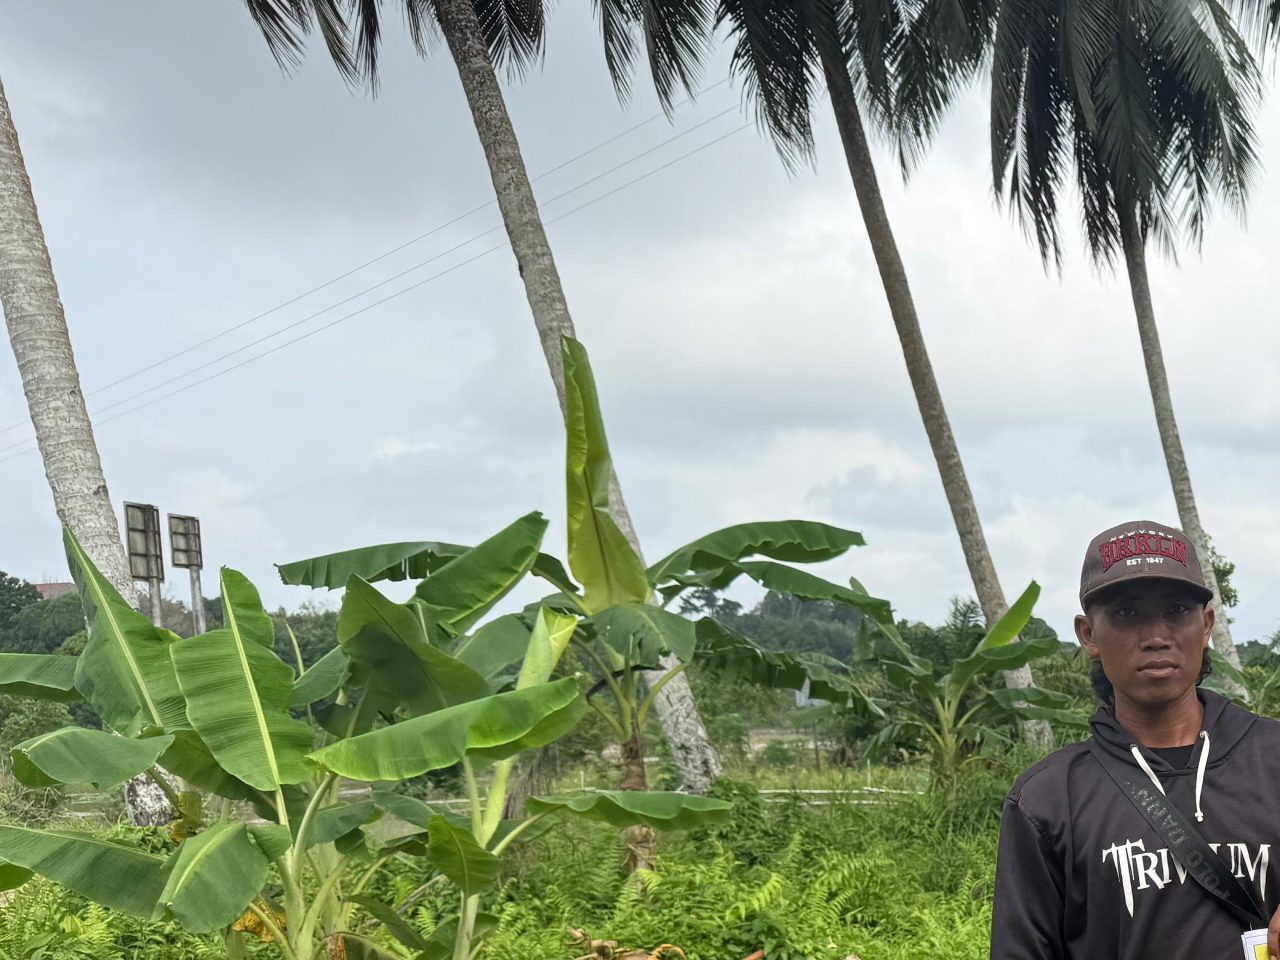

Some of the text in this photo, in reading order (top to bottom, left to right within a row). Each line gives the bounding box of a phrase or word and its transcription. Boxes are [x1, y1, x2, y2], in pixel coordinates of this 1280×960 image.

[1099, 533, 1188, 573] BRKLN
[1126, 558, 1142, 566] EST
[1102, 838, 1272, 918] TRIVUM
